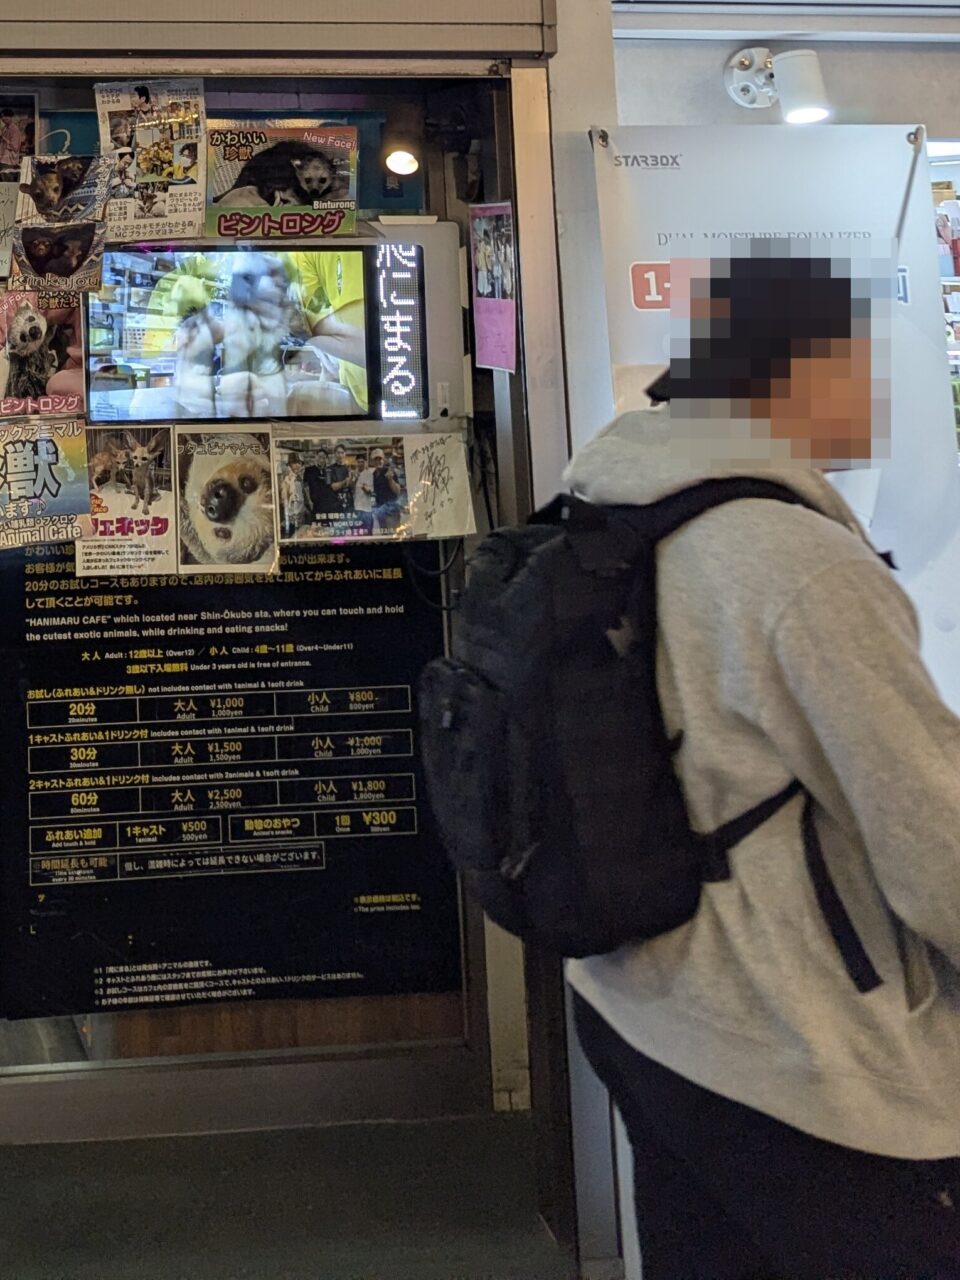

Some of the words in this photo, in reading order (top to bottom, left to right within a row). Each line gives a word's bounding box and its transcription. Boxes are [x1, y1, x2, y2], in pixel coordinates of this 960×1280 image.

[210, 131, 267, 146] かわいい
[303, 132, 325, 144] New
[327, 135, 357, 150] Face!
[223, 145, 253, 161] 珍獣
[312, 200, 356, 211] Binturong
[218, 211, 344, 237] ビントロング
[11, 273, 100, 288] Kinkajou
[38, 297, 80, 310] 珍獣だよ
[0, 396, 80, 414] ビントロング
[0, 527, 45, 546] Animal
[47, 524, 82, 542] Cafe
[113, 614, 140, 623] which
[142, 613, 176, 622] located
[178, 612, 198, 621] near
[273, 608, 301, 618] where
[302, 608, 319, 618] you
[321, 608, 337, 616] can
[339, 606, 364, 616] touch
[366, 605, 383, 614] and
[384, 604, 405, 614] hold
[25, 633, 41, 642] the
[43, 631, 72, 641] cutest
[73, 630, 101, 640] exotic
[142, 627, 166, 637] while
[167, 626, 205, 637] drinking
[206, 625, 223, 634] and
[225, 624, 253, 634] eating
[254, 623, 288, 632] snacks!
[81, 651, 101, 661] 大人
[209, 646, 228, 656] 小人
[68, 702, 96, 716] 20分
[174, 699, 198, 712] 大人
[210, 697, 244, 709] ¥1,000
[307, 692, 331, 705] 小人
[70, 747, 97, 760] 30分
[171, 742, 195, 756] 大人
[208, 741, 242, 753] ¥1,500
[311, 736, 335, 750] 小人
[71, 792, 98, 805] 60分
[171, 789, 195, 802] 大人
[208, 788, 242, 800] ¥2,500
[314, 780, 338, 794] 小人
[181, 821, 207, 832] ¥500
[362, 811, 397, 826] ¥300
